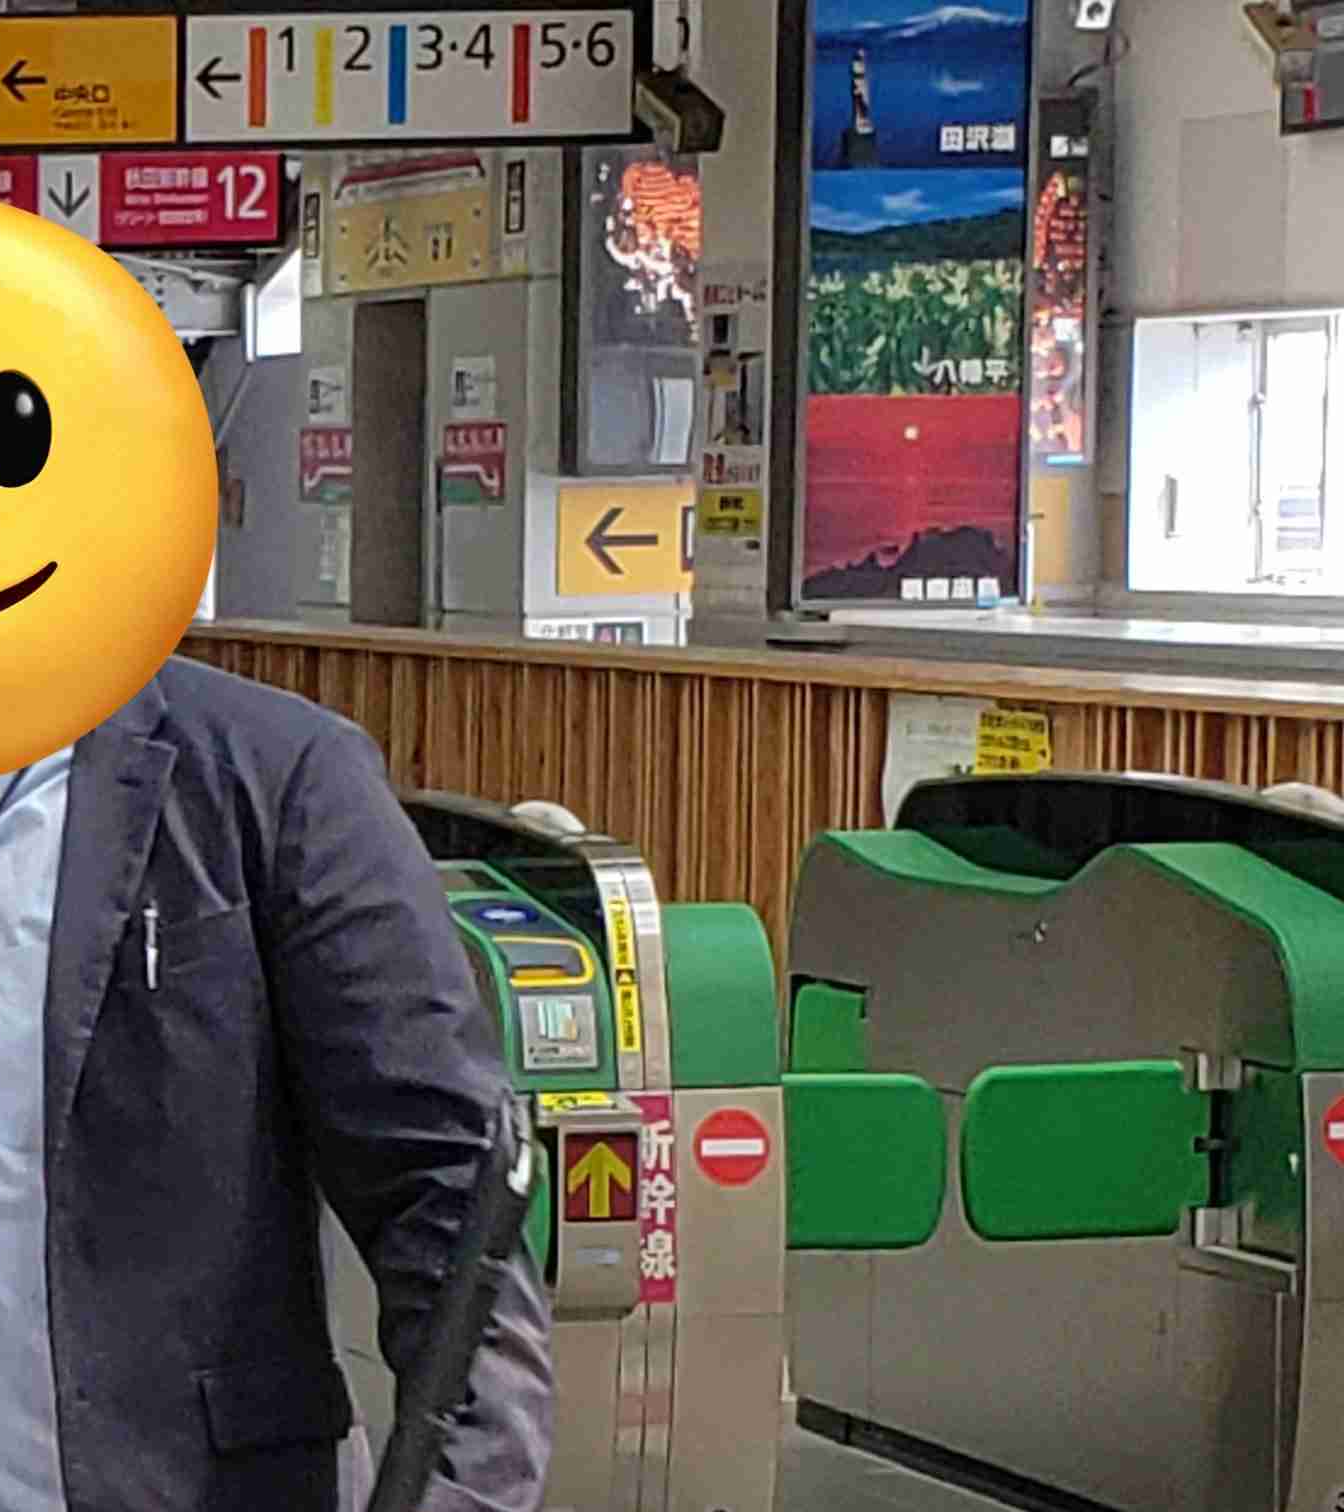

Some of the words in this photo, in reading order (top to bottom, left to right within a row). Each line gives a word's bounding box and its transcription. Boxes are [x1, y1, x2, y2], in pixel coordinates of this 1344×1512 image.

[277, 26, 296, 72] 1
[343, 25, 372, 71] 2
[216, 164, 267, 221] 12
